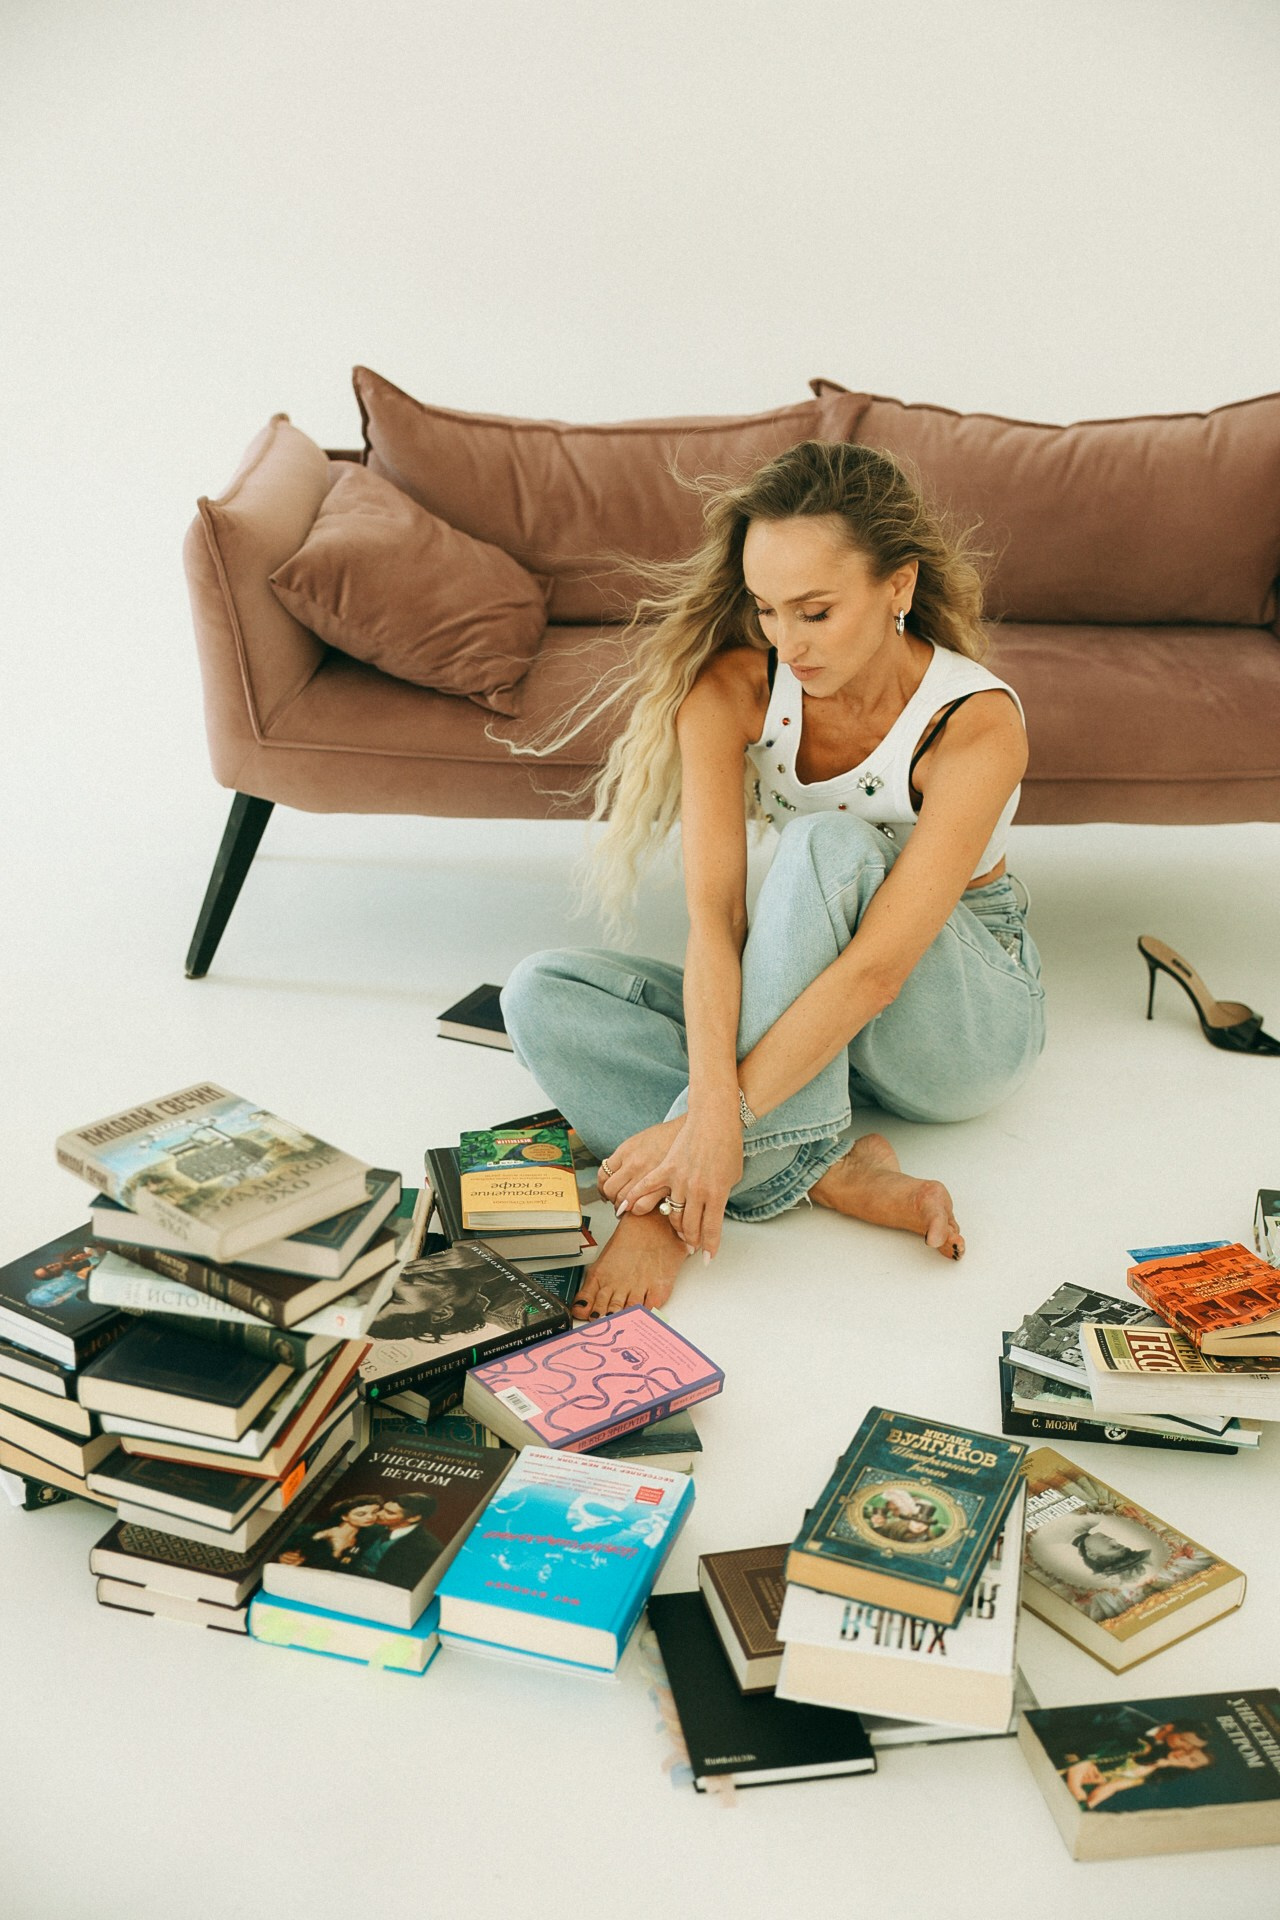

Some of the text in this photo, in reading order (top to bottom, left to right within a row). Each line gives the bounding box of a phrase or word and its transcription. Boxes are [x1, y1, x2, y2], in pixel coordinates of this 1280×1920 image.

[77, 1085, 226, 1146] НИКОЛАЙ СВЕЧИН
[264, 1179, 311, 1205] ЭХО
[470, 1189, 565, 1198] Возвращение
[490, 1181, 530, 1190] кафе
[471, 1246, 519, 1283] Макконахи
[148, 1290, 242, 1314] ИСТОЧН
[518, 1282, 554, 1310] Мэттью
[483, 1328, 554, 1357] Мэттью Макконахи
[1126, 1330, 1184, 1372] ГЕССЕ
[924, 1429, 973, 1447] МИХАИЛ
[1032, 1418, 1077, 1431] С. МОЭМ
[886, 1429, 998, 1468] БУЛГАКОВ
[369, 1452, 484, 1480] УНЕСЕННЫЕ
[381, 1467, 452, 1487] ВЕТРОМ
[840, 1601, 947, 1656] ХАНЬЯ
[1216, 1714, 1266, 1769] ВЕТРОМ
[1226, 1698, 1280, 1774] УНЕСЕНН
